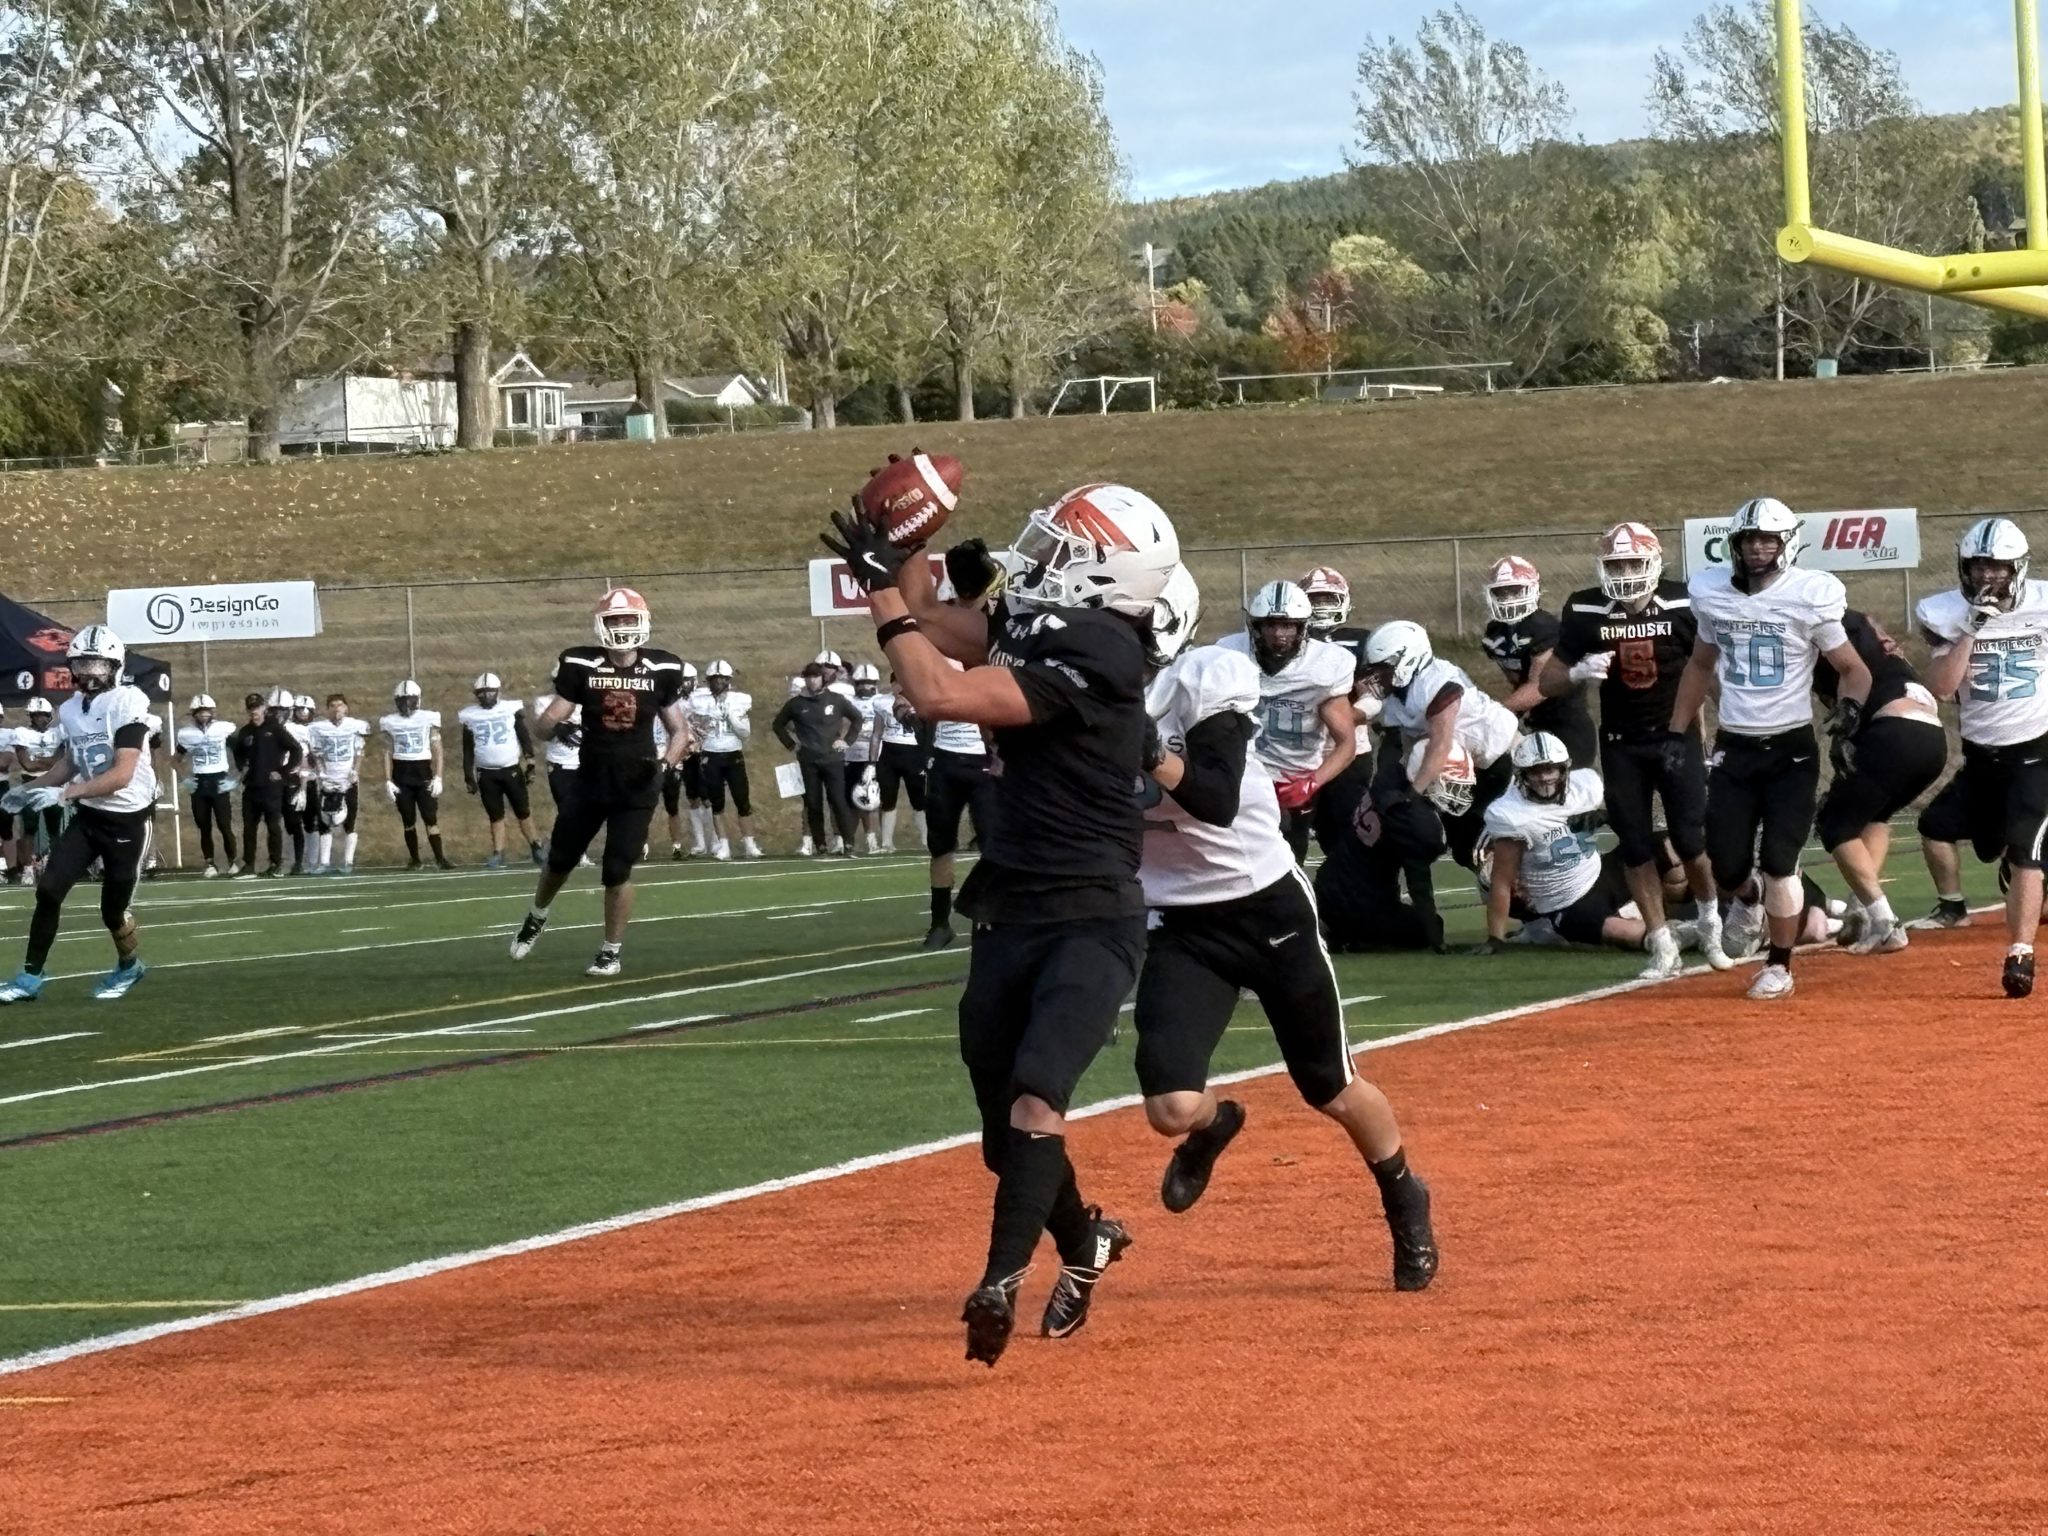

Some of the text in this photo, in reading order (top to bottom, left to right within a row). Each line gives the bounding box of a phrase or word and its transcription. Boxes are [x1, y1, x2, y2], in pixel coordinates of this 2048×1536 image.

[1822, 517, 1888, 550] IGA
[190, 594, 280, 617] DesignGo
[1600, 622, 1672, 640] RIMOUSKI
[1716, 634, 1785, 686] 10
[588, 676, 655, 692] RIMOUSKI
[1093, 1235, 1111, 1268] NIKE
